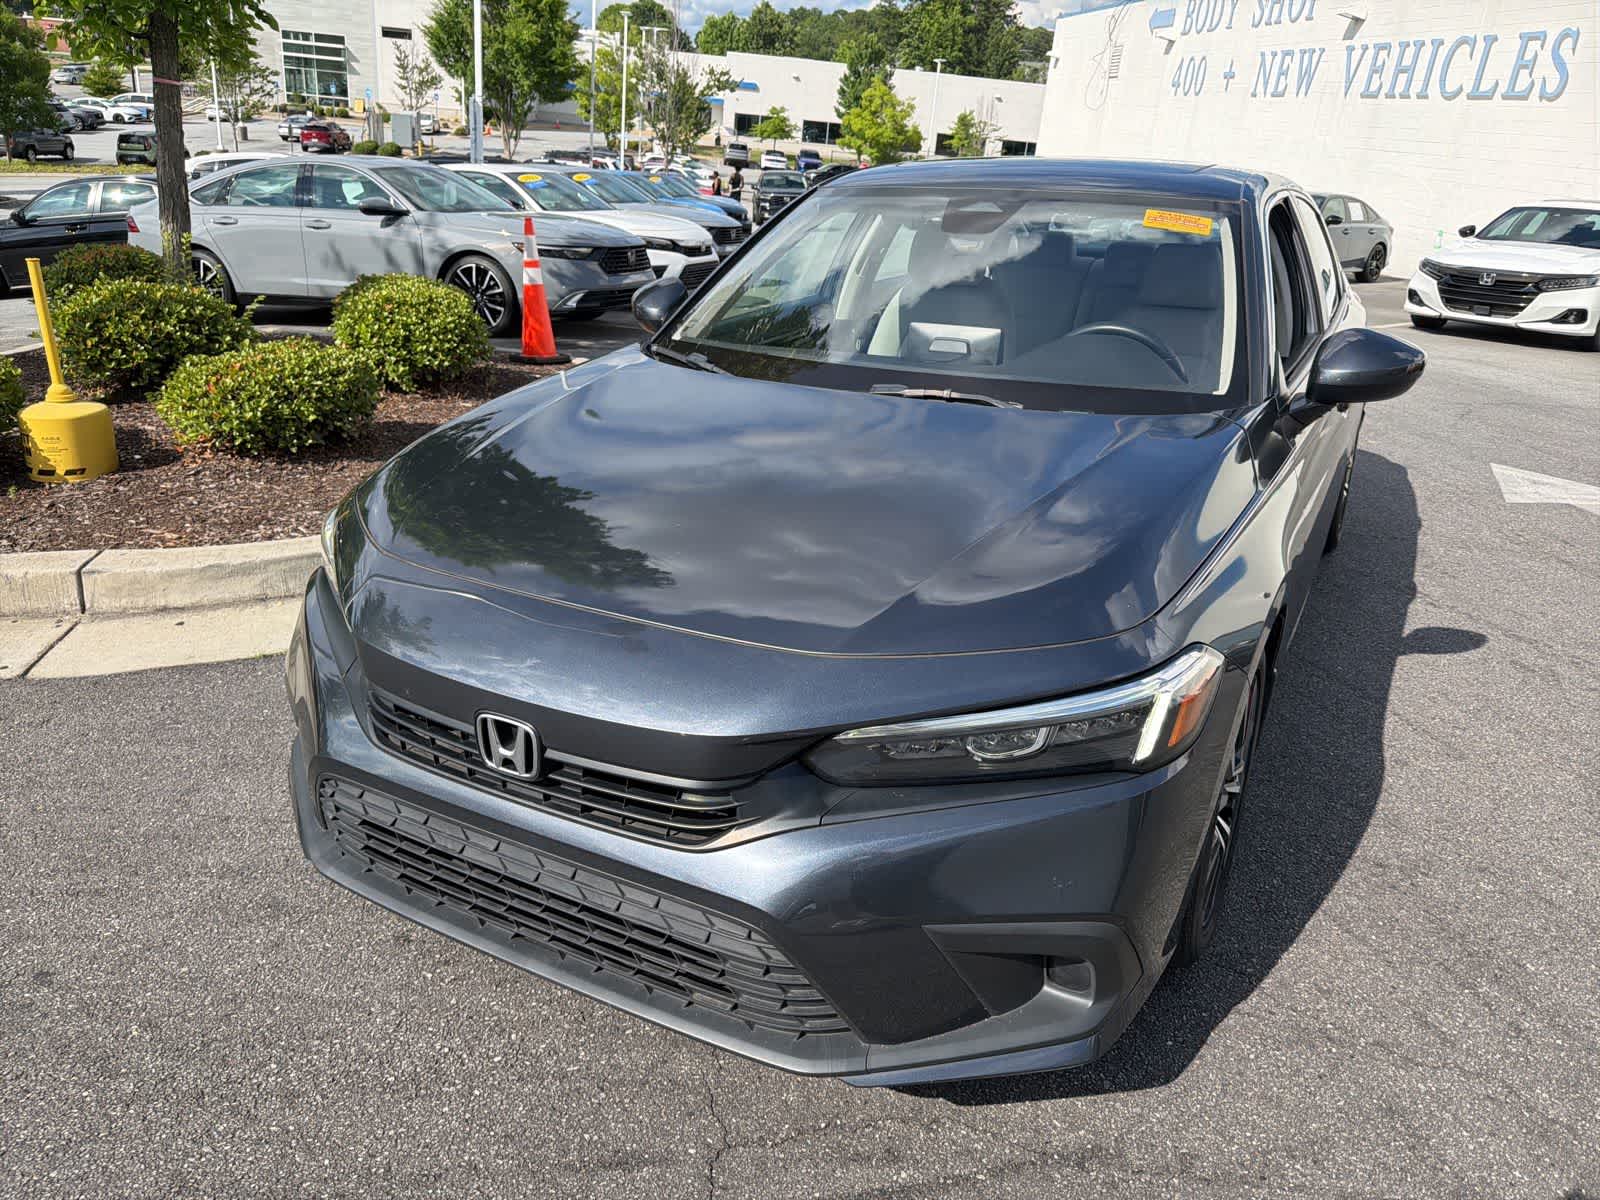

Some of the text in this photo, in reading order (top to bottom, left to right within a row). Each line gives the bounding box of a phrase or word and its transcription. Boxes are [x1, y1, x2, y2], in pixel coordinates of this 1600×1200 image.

[1181, 0, 1239, 36] BODY
[1171, 26, 1580, 102] 400 + NEW VEHICLES
